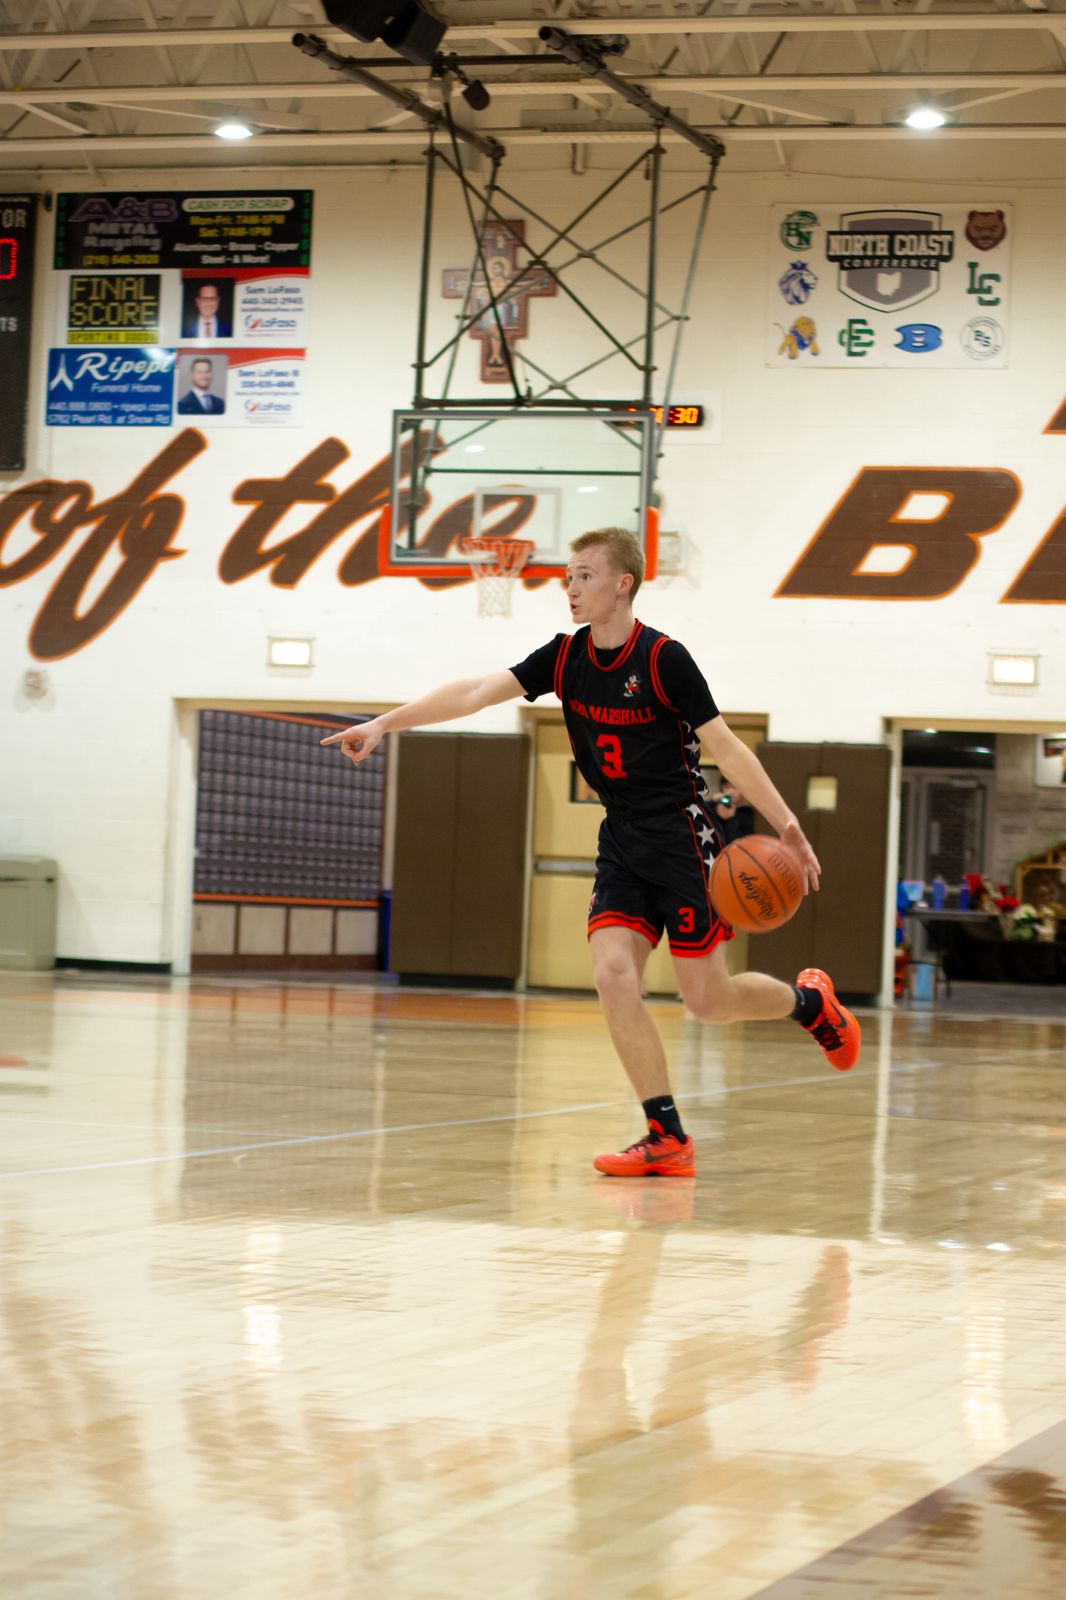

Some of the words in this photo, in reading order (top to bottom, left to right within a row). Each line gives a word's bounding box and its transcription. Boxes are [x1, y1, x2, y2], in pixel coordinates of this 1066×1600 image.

[223, 199, 245, 210] FOR
[0, 208, 27, 228] OR
[88, 223, 158, 234] METAL
[829, 235, 889, 256] NORTH
[895, 234, 952, 255] COAST
[843, 258, 938, 268] CONFERENCE
[71, 278, 155, 300] FINAL
[71, 302, 157, 325] SCORE
[589, 705, 656, 725] MARSHALL
[596, 734, 628, 778] 3
[678, 907, 695, 933] 3
